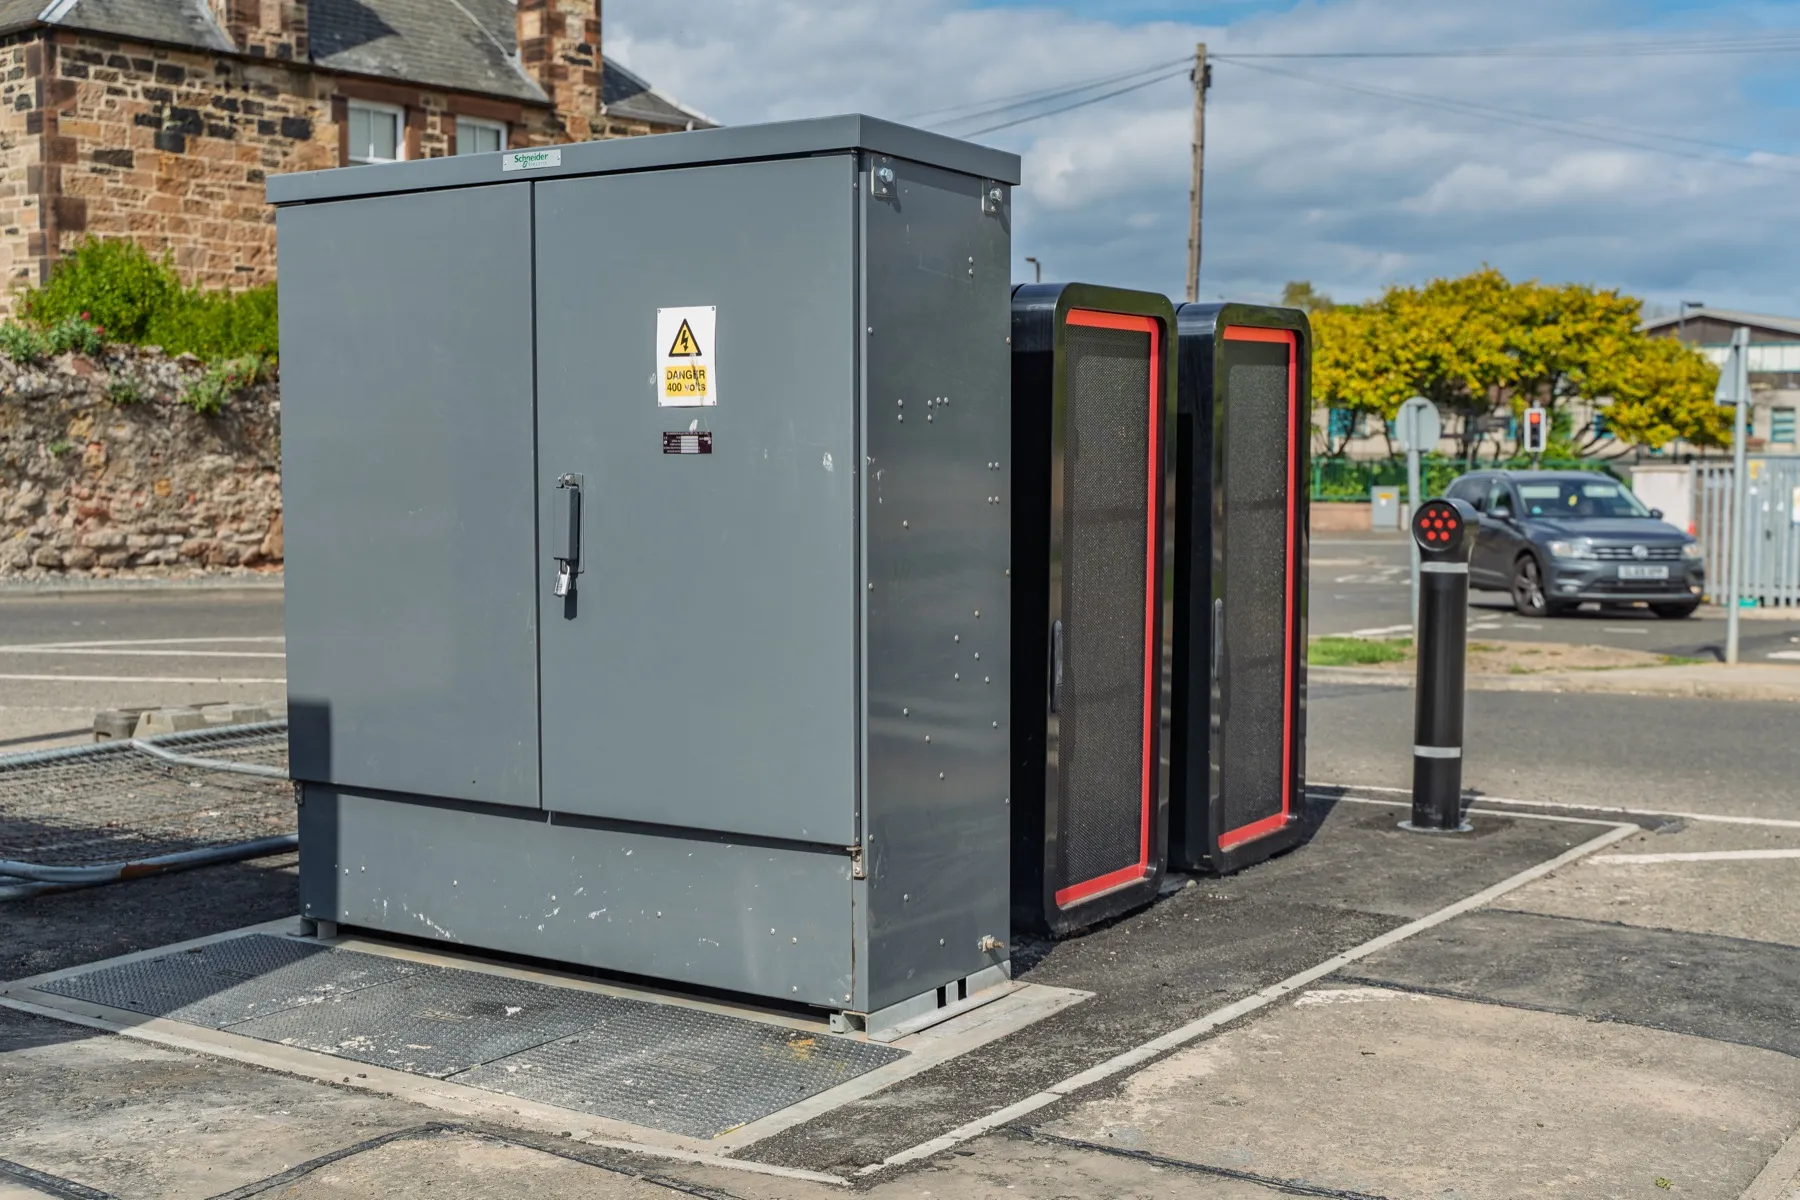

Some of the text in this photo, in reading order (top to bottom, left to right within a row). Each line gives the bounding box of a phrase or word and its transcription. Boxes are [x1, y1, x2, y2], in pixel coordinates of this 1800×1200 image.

[514, 152, 549, 163] Schneider
[666, 370, 705, 380] DANGER
[667, 382, 682, 392] 400
